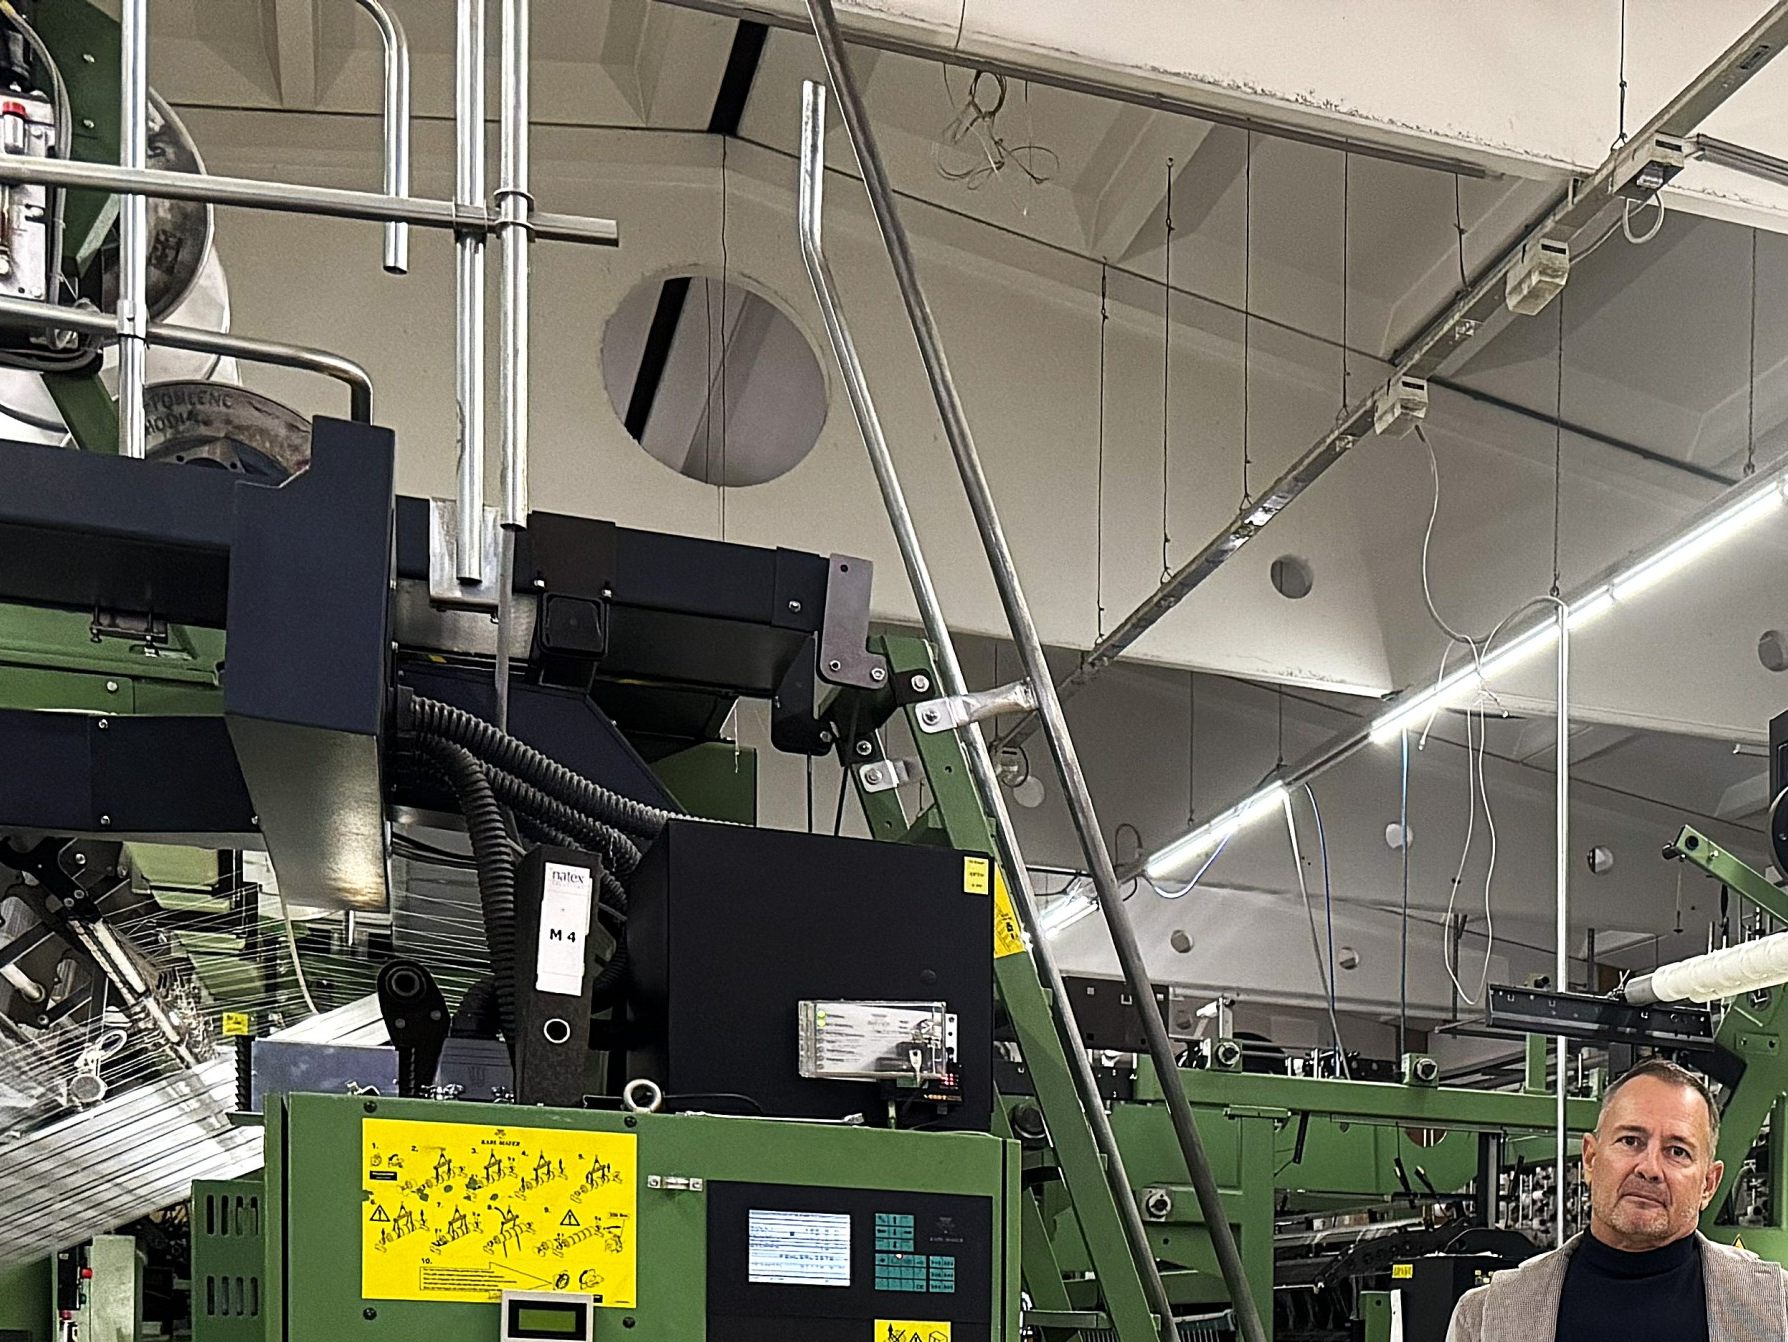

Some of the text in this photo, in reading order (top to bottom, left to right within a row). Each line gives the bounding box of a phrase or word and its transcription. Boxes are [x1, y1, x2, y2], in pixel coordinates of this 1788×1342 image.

[552, 870, 585, 884] natex
[549, 928, 576, 943] M 4
